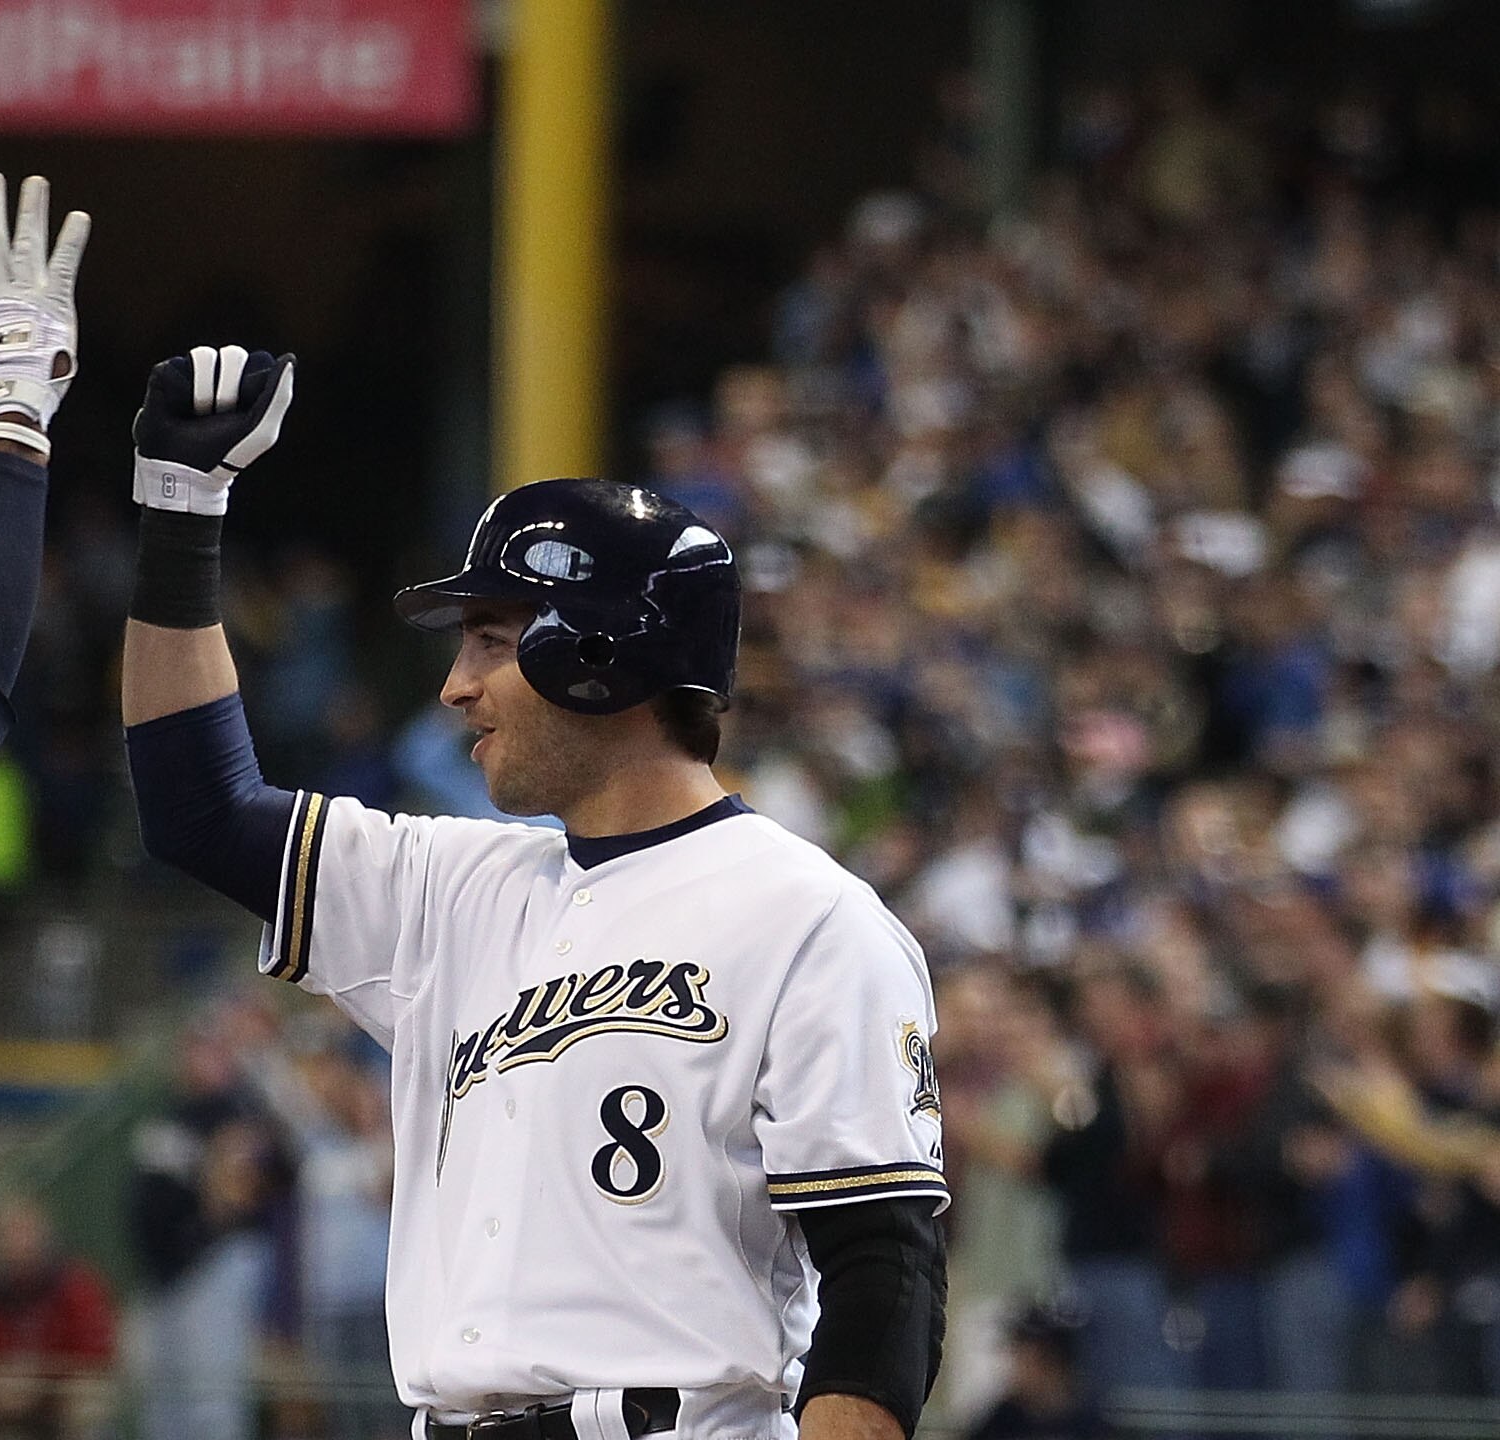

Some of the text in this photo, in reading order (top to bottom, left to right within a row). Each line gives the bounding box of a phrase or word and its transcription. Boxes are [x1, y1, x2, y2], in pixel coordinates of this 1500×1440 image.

[162, 473, 176, 498] 8
[445, 957, 728, 1100] rewers
[591, 1082, 670, 1206] 8
